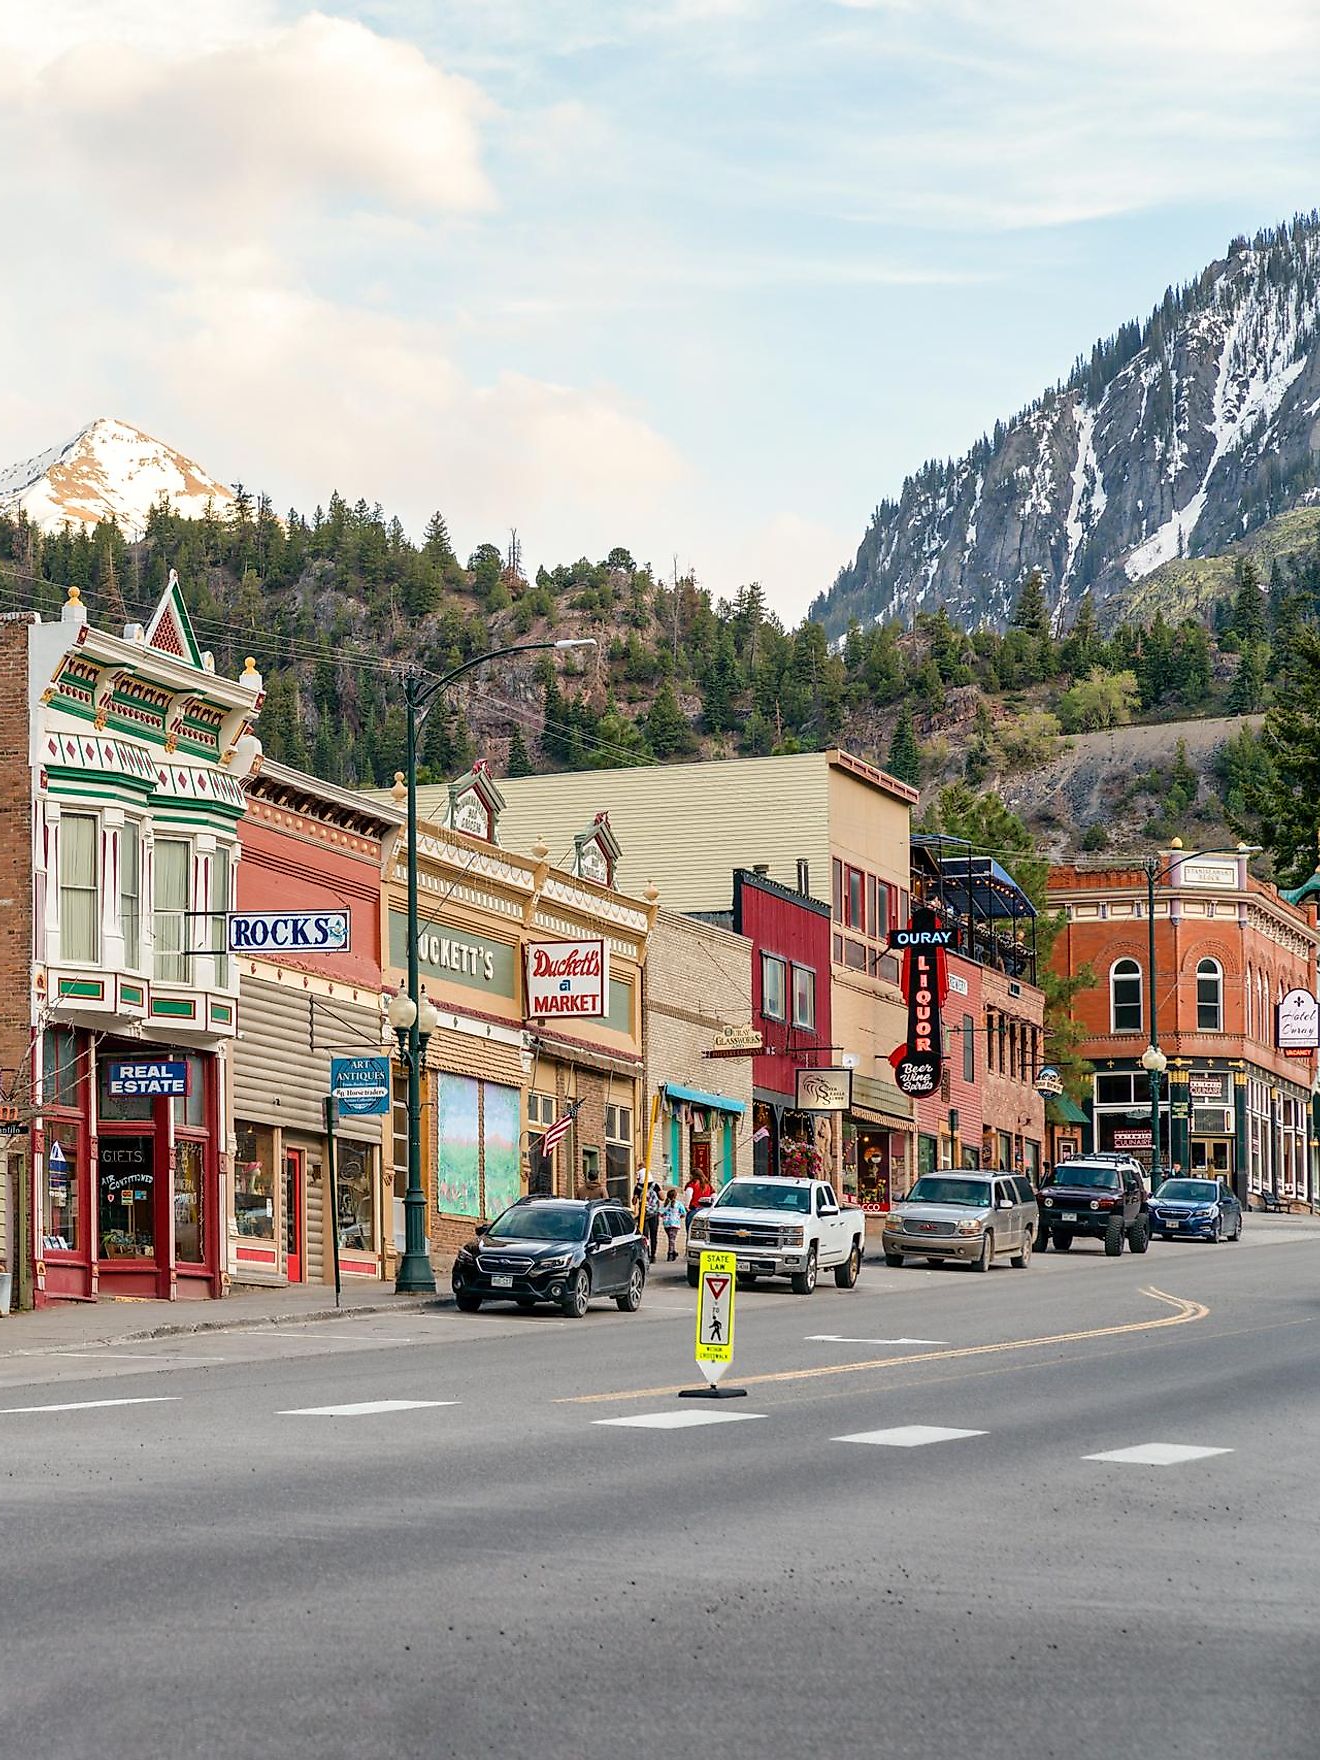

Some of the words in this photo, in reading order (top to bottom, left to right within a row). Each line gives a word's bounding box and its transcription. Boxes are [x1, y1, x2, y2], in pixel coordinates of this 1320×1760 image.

[233, 918, 330, 947] ROCKS
[897, 931, 952, 944] OURAY
[407, 930, 494, 980] UCKETT'S
[533, 948, 600, 978] Duckett's
[534, 994, 599, 1012] MARKET
[915, 955, 932, 1052] LIQUOR
[1281, 1010, 1316, 1021] Hotel
[1282, 1023, 1314, 1037] Ouray
[352, 1060, 371, 1069] ART
[901, 1062, 934, 1073] Beer
[120, 1065, 174, 1079] REAL
[336, 1071, 385, 1082] ANTIQUES
[900, 1072, 932, 1082] Wine
[111, 1080, 185, 1094] ESTATE
[901, 1081, 934, 1092] Spirits
[101, 1174, 116, 1186] AIR
[707, 1254, 729, 1263] STATE
[710, 1263, 726, 1271] LAW
